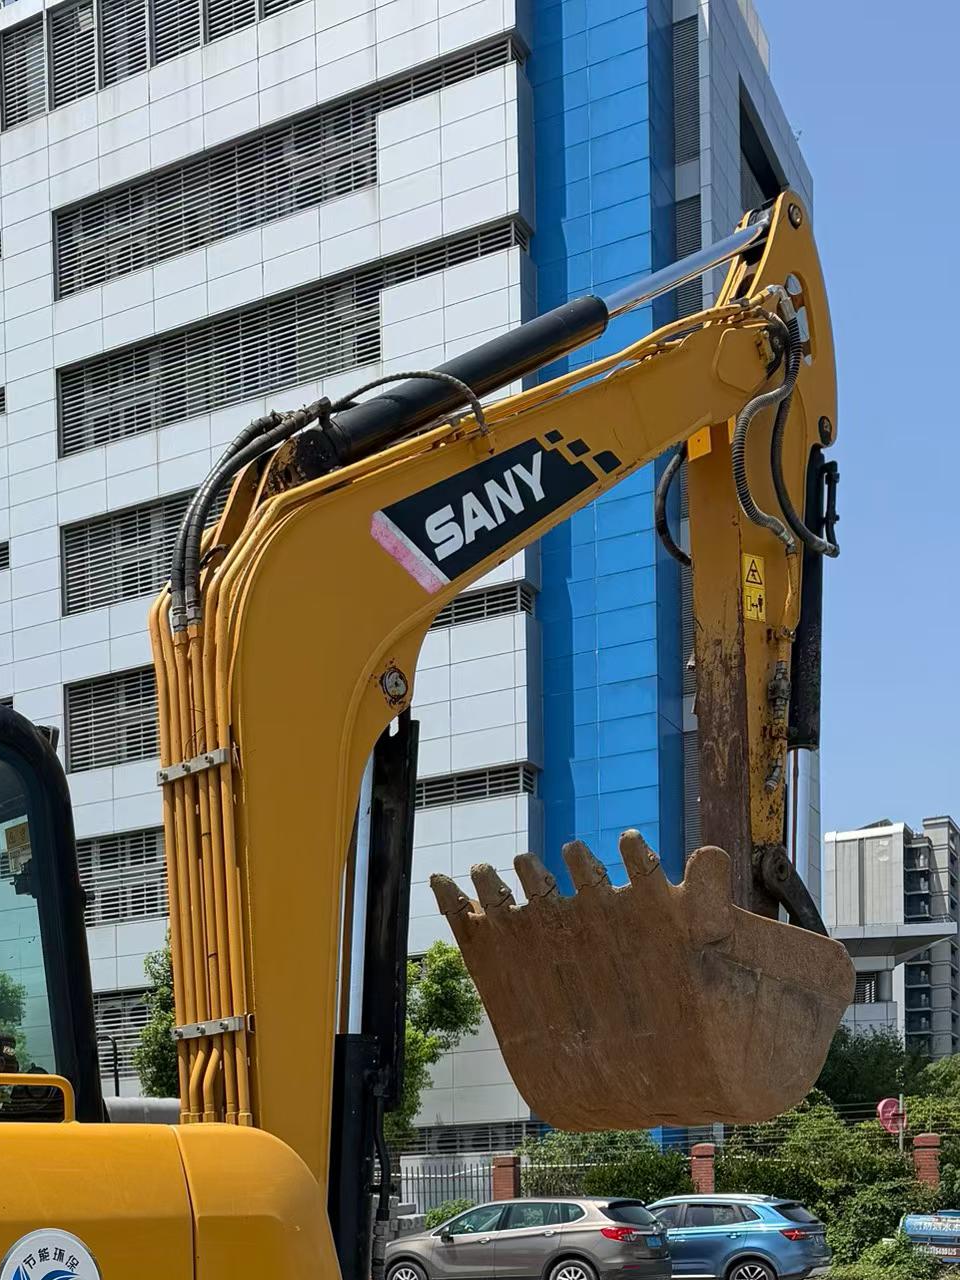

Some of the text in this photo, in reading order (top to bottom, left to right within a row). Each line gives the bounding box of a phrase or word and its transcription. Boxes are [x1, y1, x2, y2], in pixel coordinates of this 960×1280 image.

[425, 450, 546, 561] SANY
[22, 1247, 80, 1272] 节能环保
